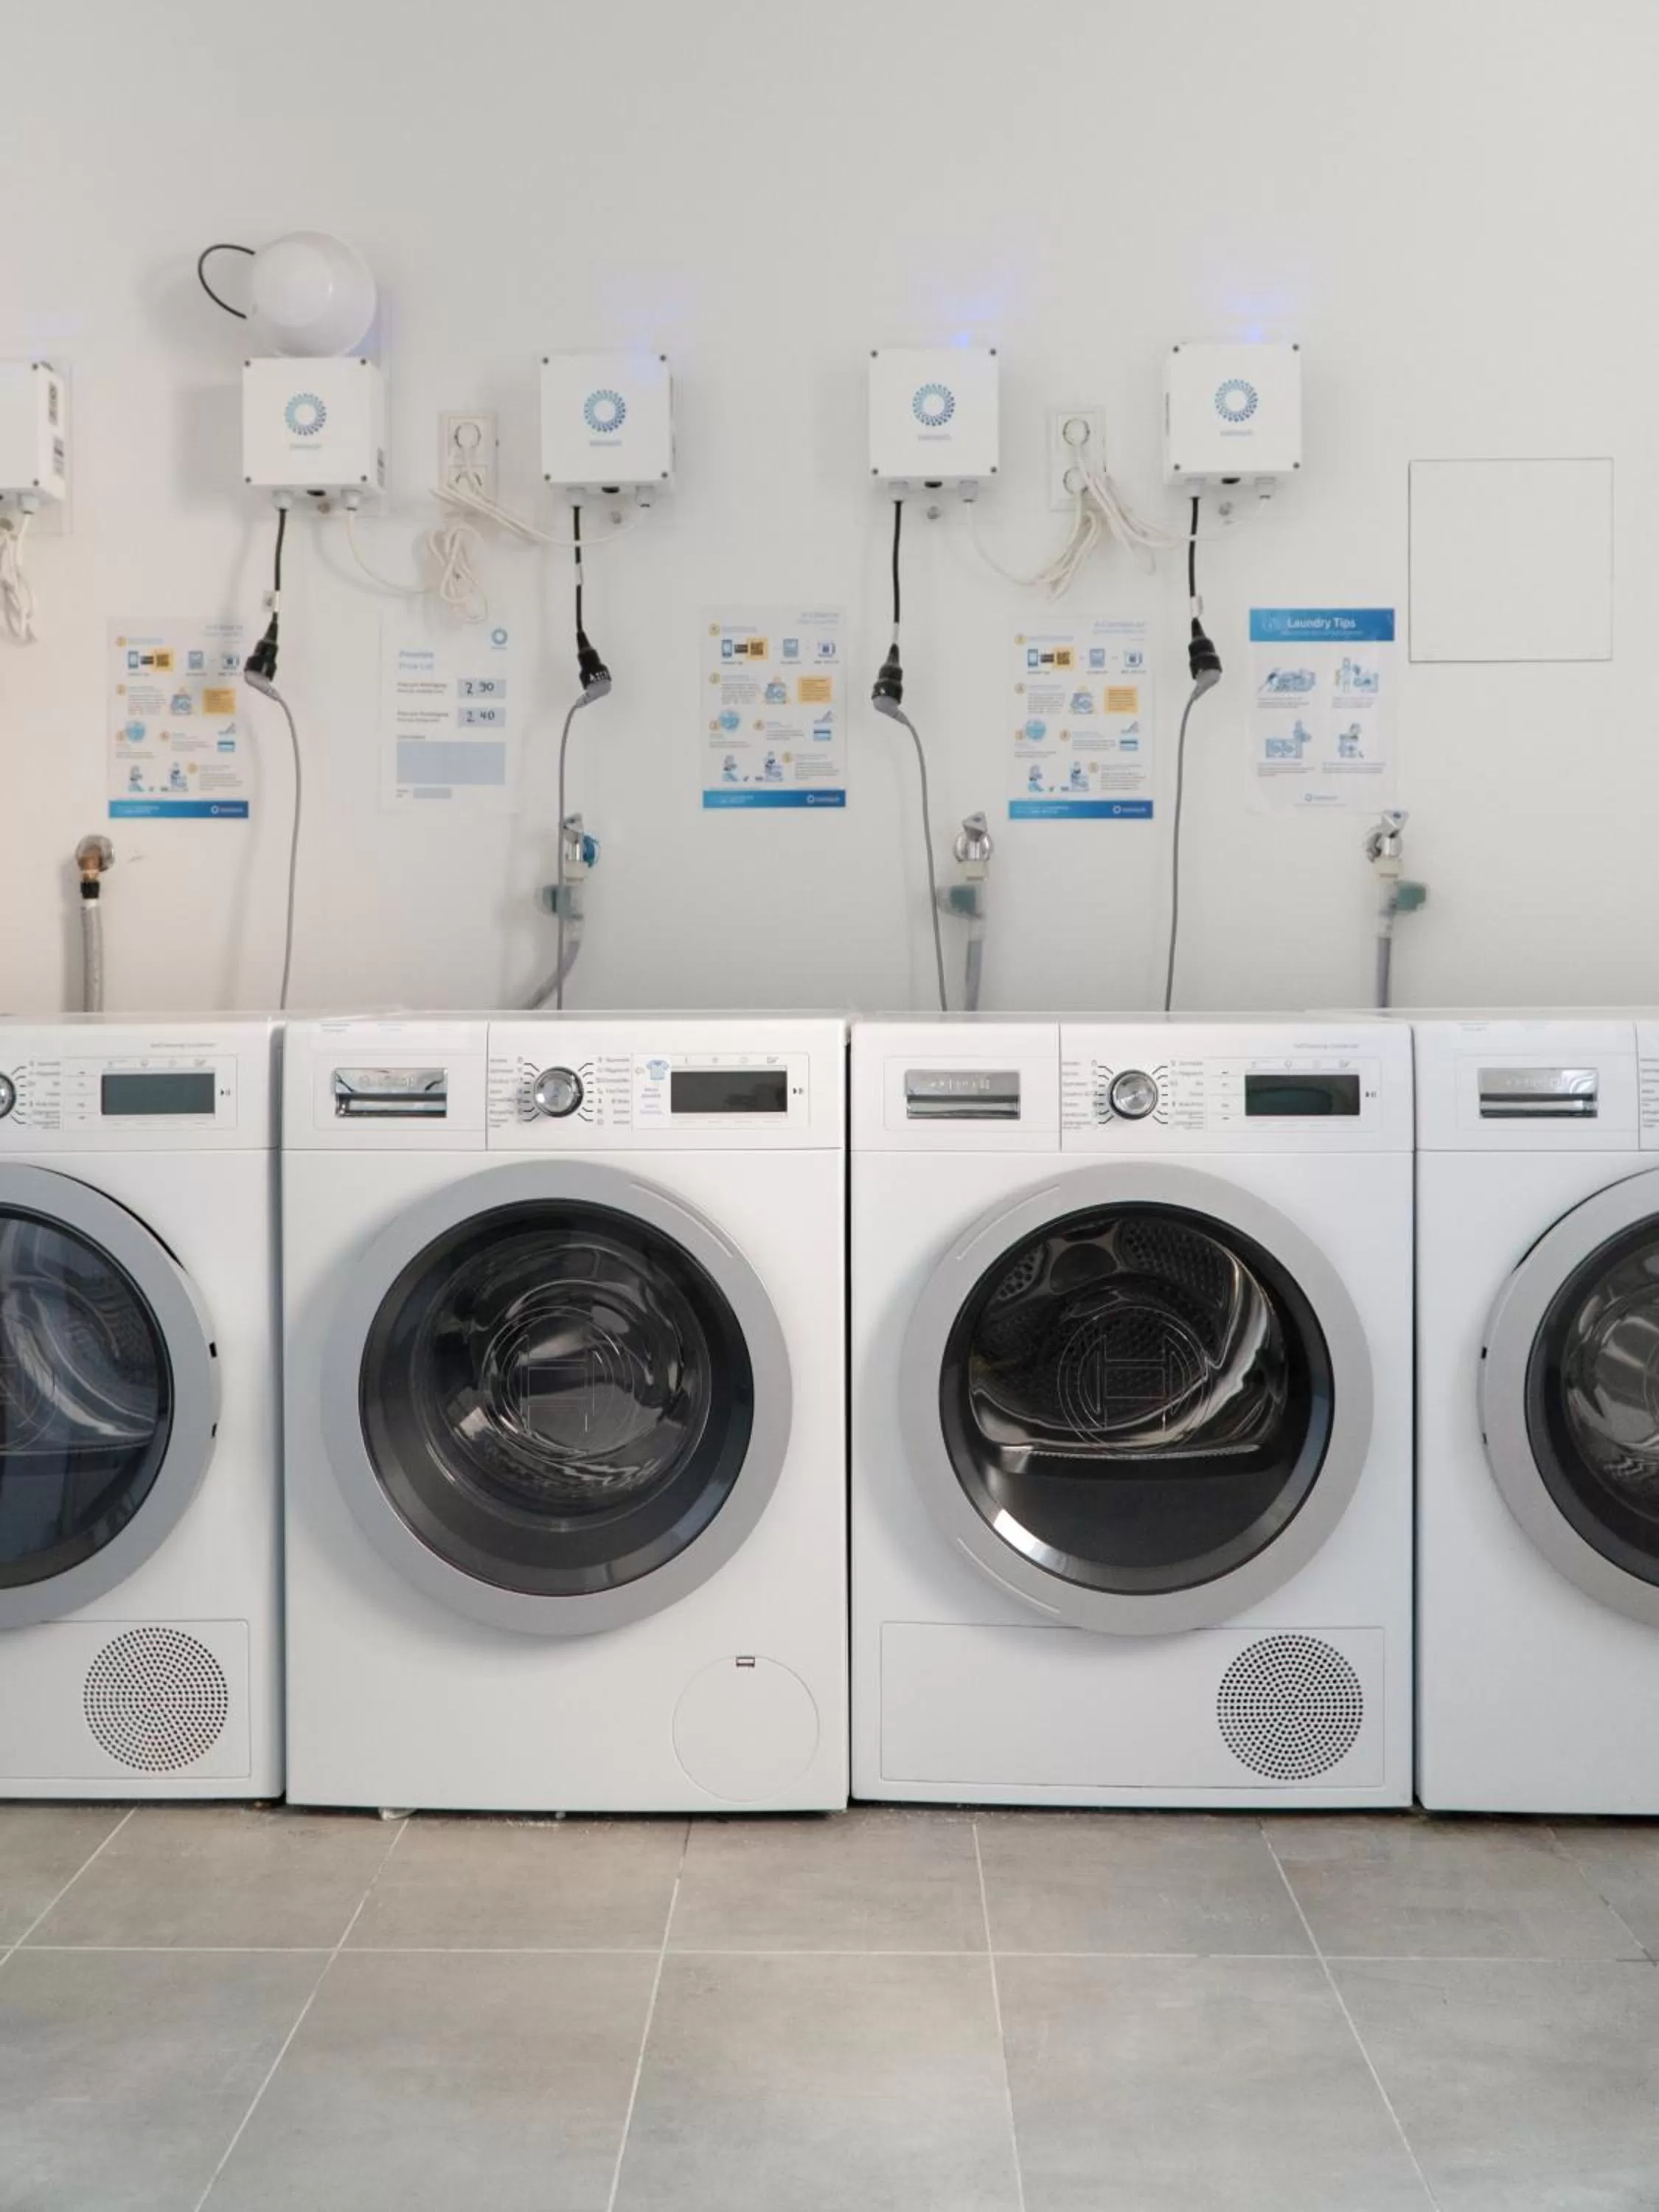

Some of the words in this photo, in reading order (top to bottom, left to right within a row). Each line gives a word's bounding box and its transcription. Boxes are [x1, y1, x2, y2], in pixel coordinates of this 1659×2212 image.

[1287, 617, 1331, 630] Laundry
[1333, 617, 1357, 630] Tips
[479, 709, 495, 721] 40
